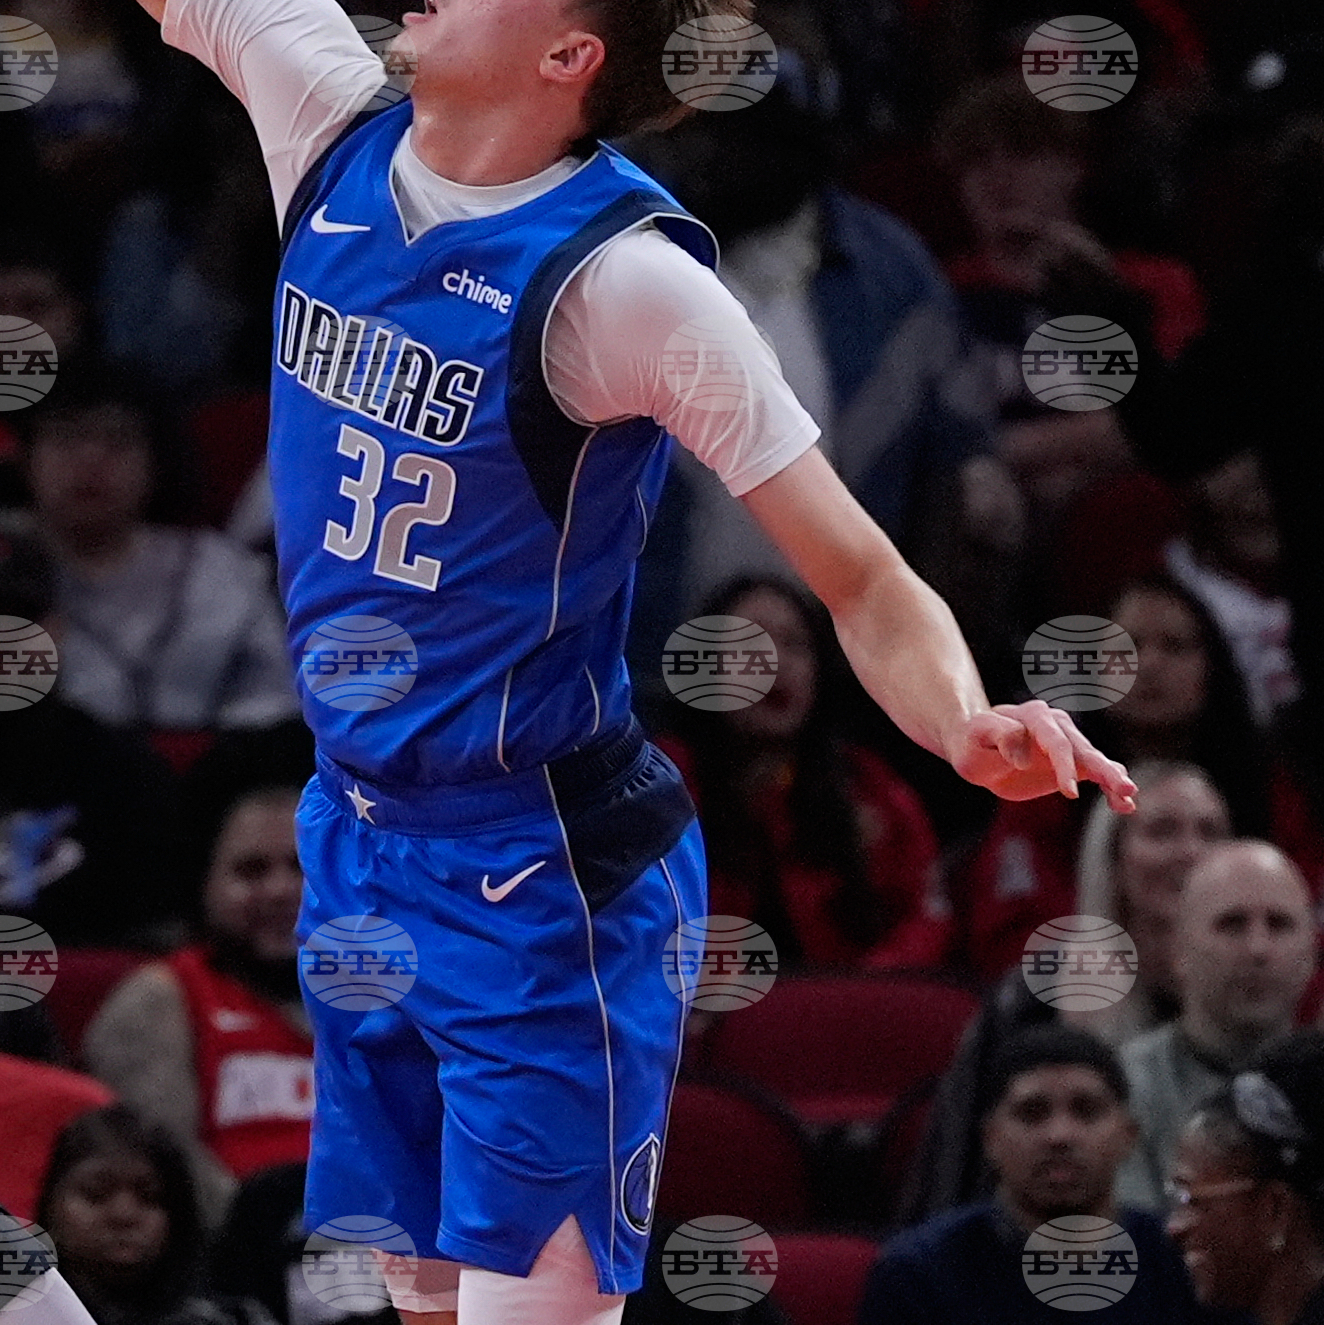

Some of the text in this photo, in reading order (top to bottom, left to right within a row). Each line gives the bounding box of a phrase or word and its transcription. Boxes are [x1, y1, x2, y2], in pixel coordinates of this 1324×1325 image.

[278, 281, 484, 447] DALLAS
[442, 268, 512, 314] chime
[323, 424, 456, 591] 32
